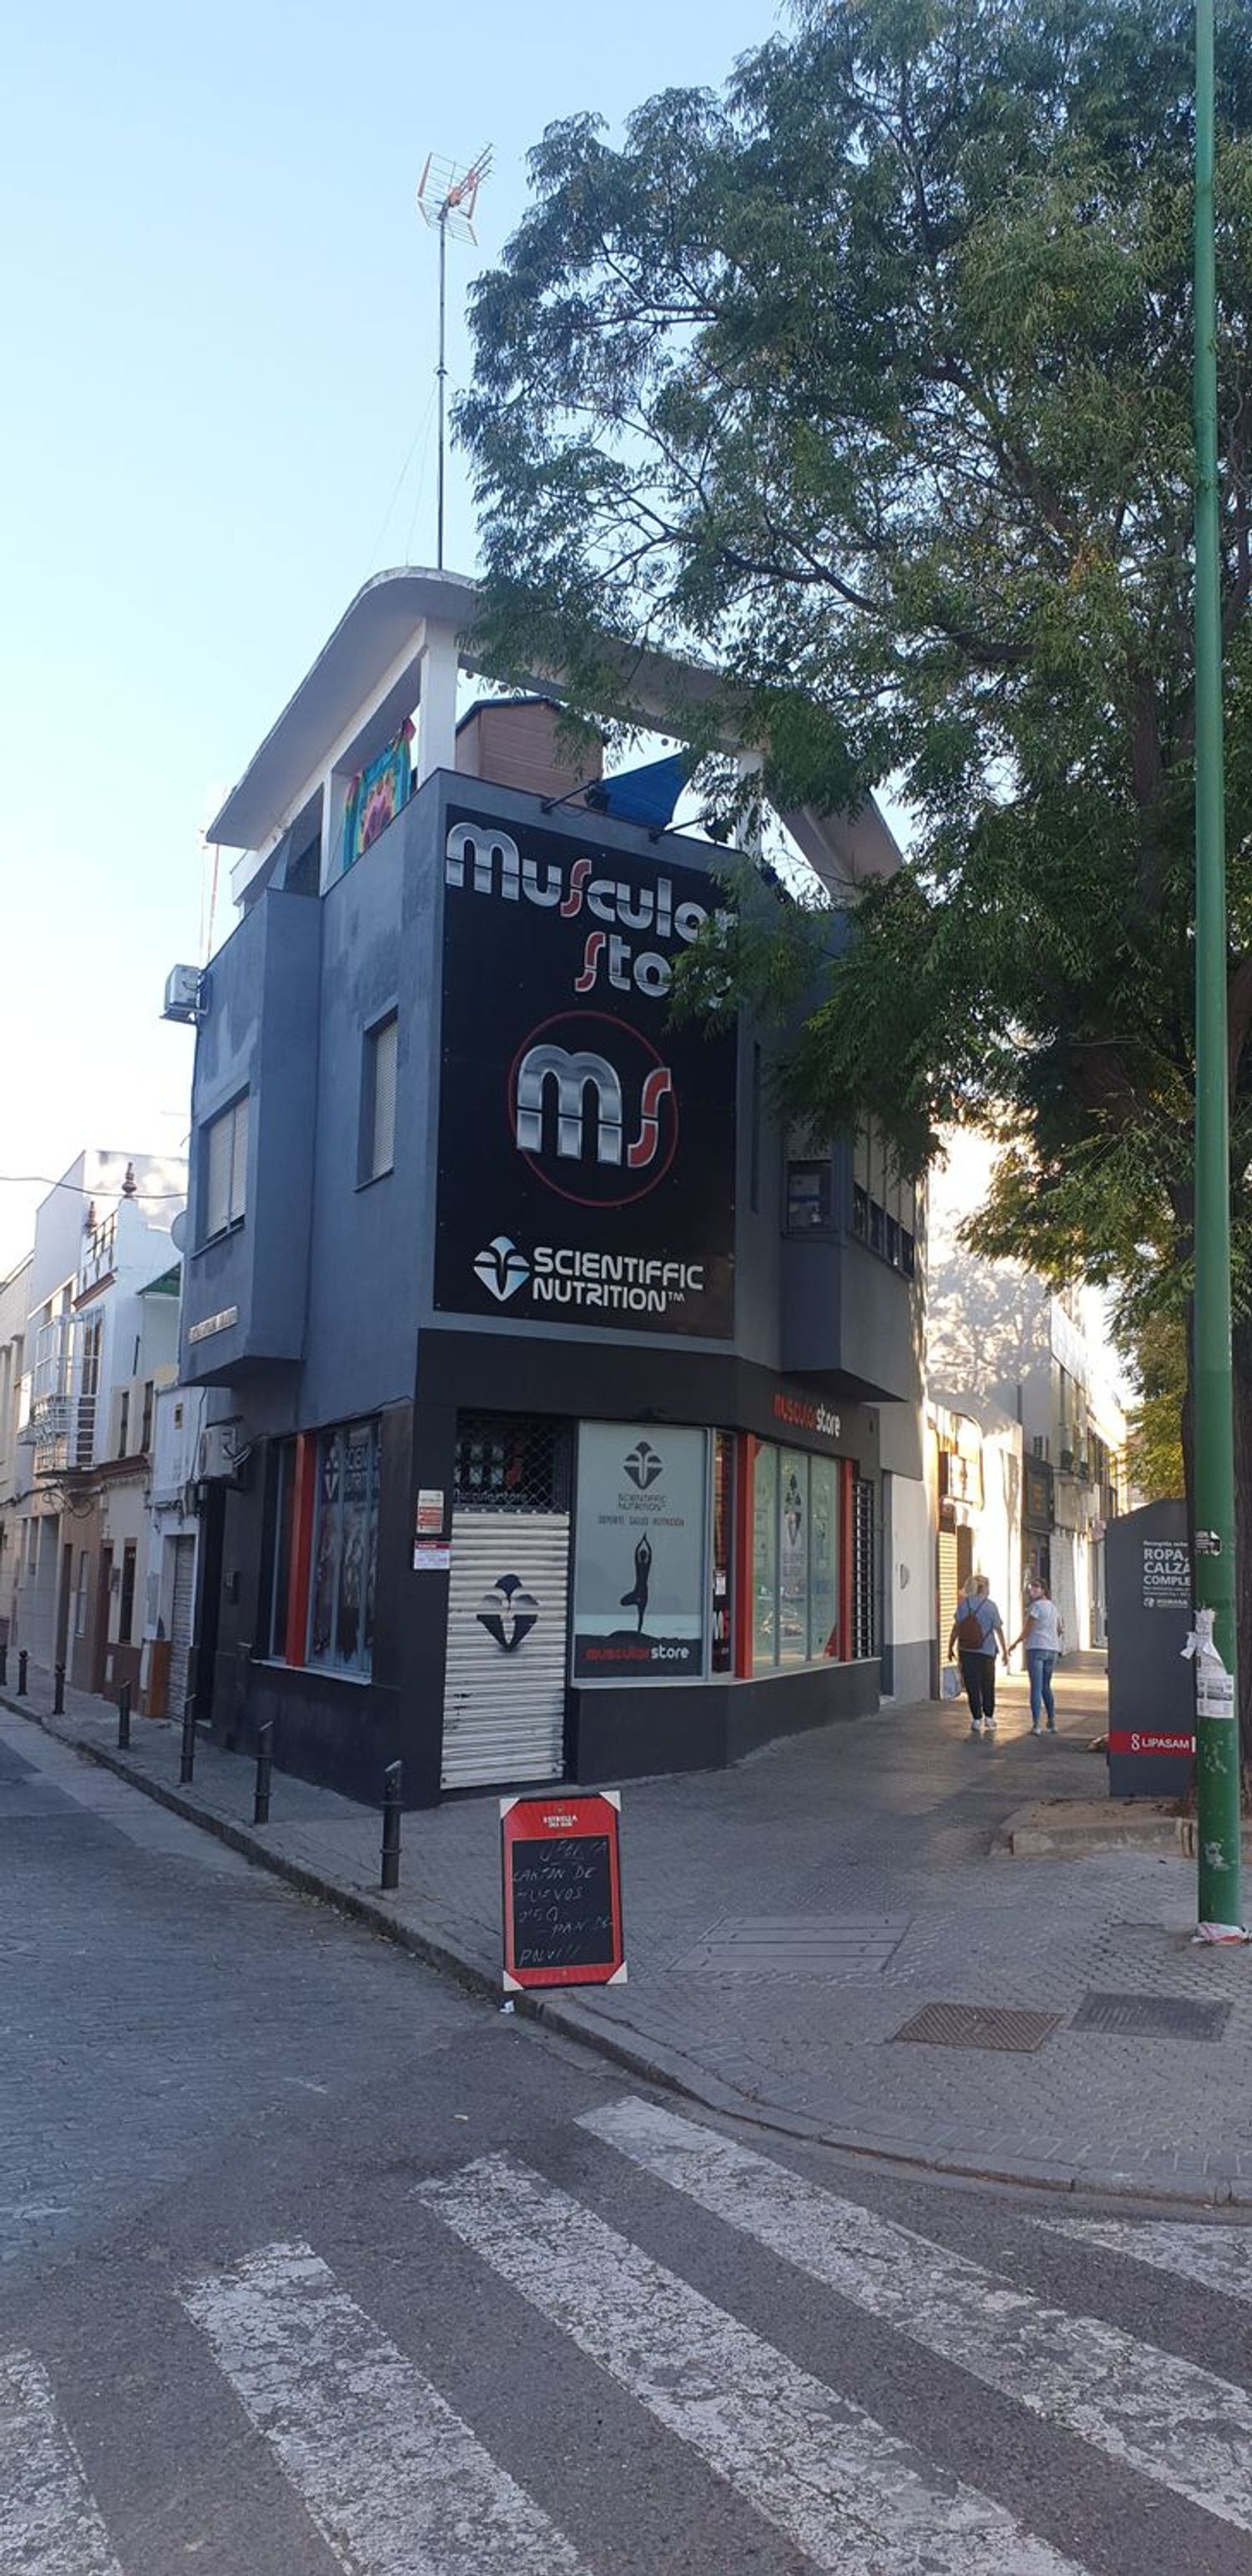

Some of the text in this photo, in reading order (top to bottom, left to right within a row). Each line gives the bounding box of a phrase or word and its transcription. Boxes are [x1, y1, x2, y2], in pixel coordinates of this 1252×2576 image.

[533, 1247, 704, 1290] SCIENTIFFIC
[533, 1277, 667, 1312] NUTRITION
[1143, 1548, 1189, 1562] ROPA,
[1142, 1738, 1189, 1749] LIPASAM
